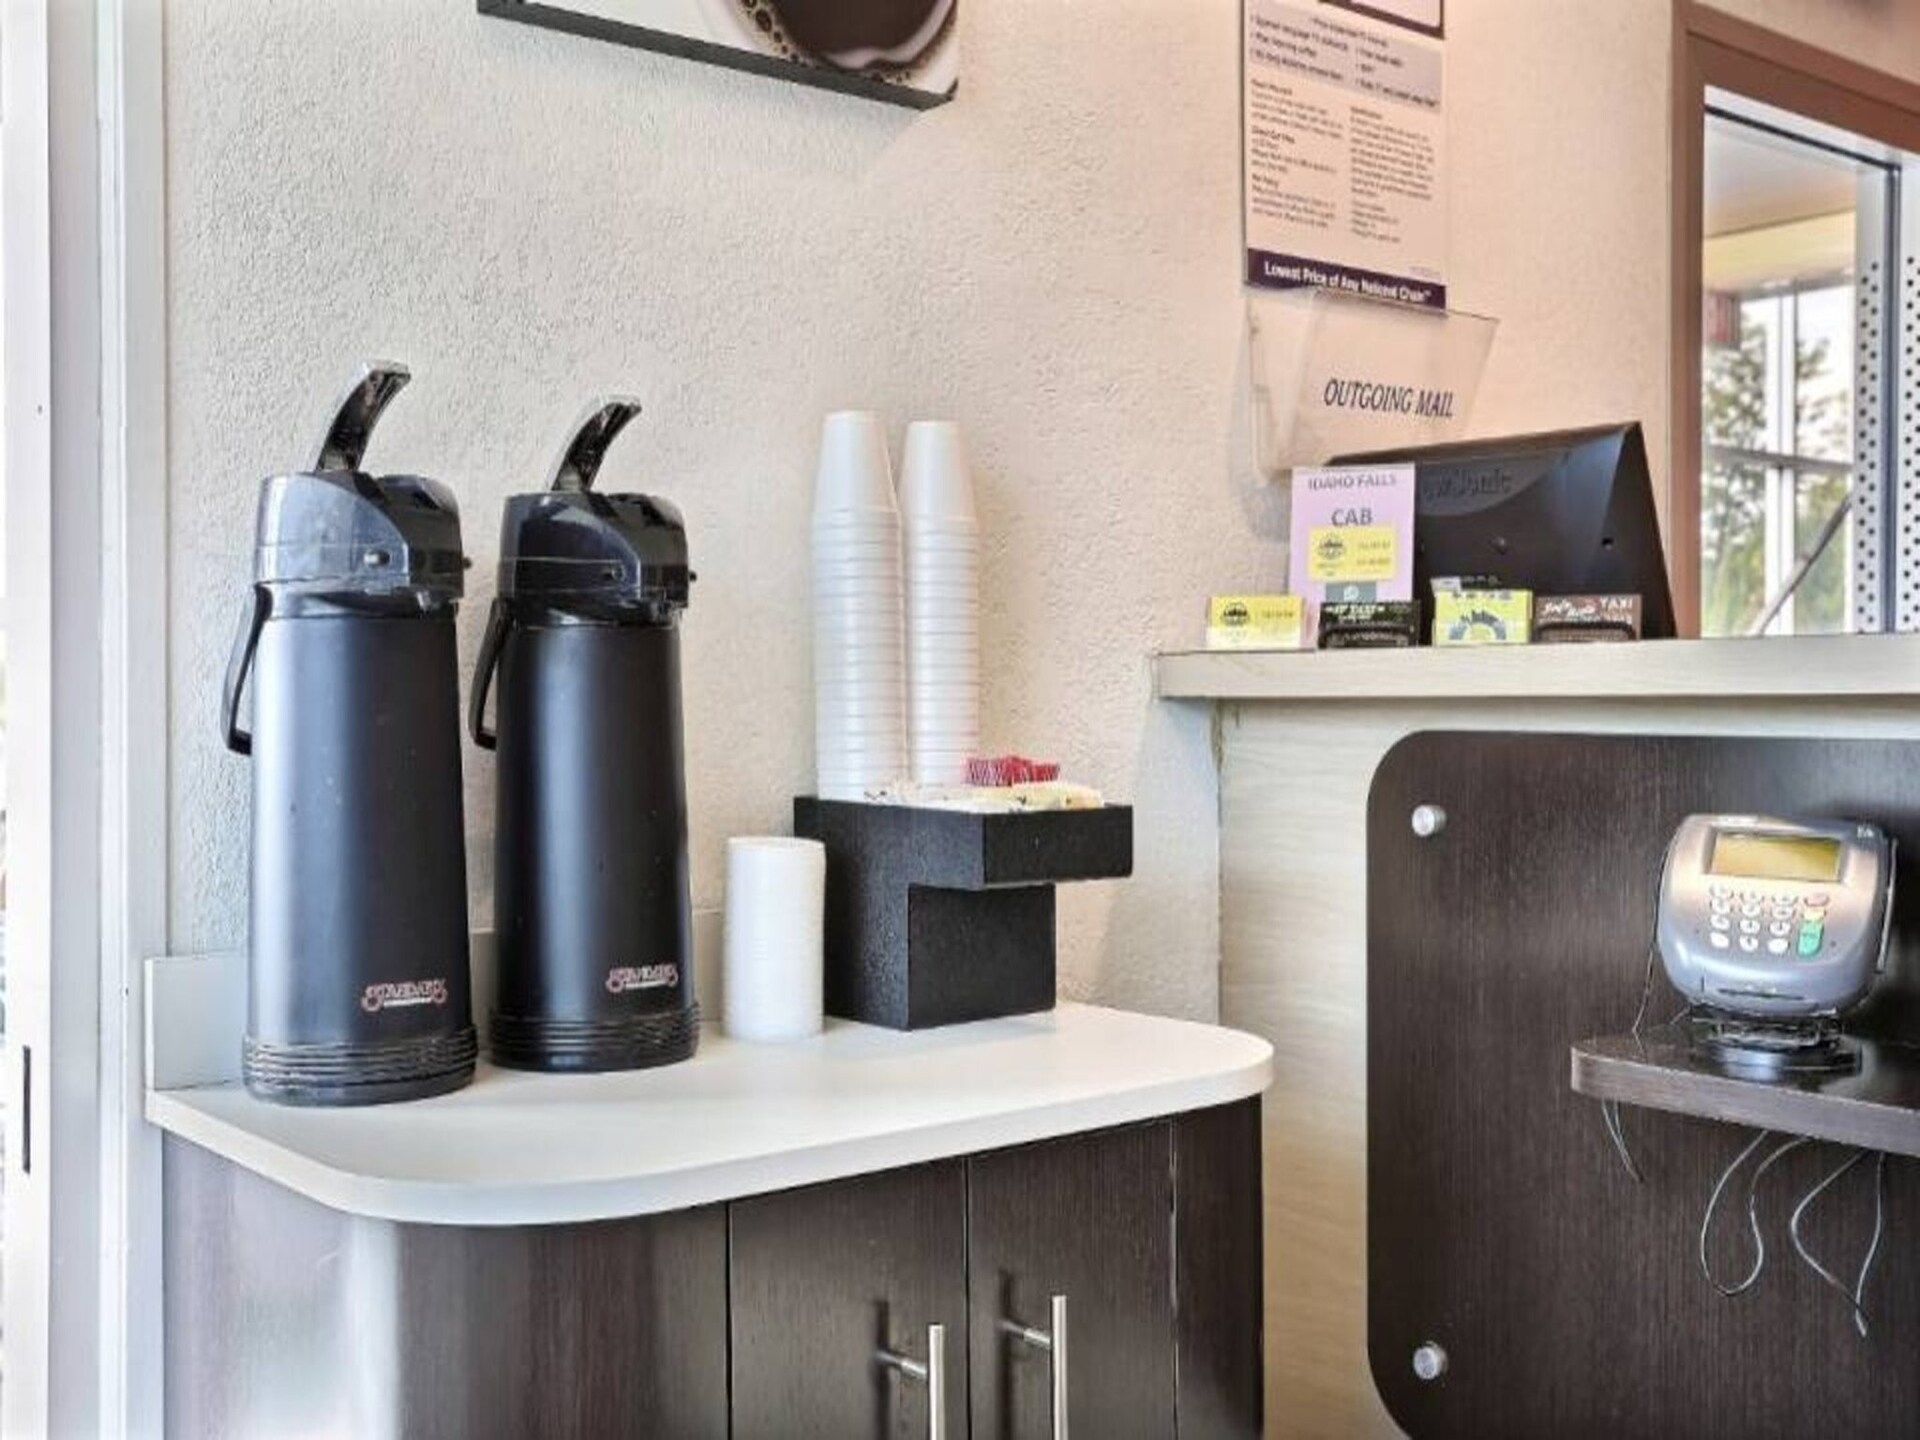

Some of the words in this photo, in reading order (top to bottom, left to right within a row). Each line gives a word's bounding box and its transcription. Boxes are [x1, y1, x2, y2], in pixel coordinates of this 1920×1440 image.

[1303, 268, 1326, 285] Price
[1329, 274, 1339, 286] of
[1323, 378, 1412, 414] OUTGOING
[1415, 390, 1454, 417] MAIL
[1308, 475, 1355, 490] IDAHO
[1357, 473, 1397, 488] FALLS
[1331, 508, 1374, 527] CAB
